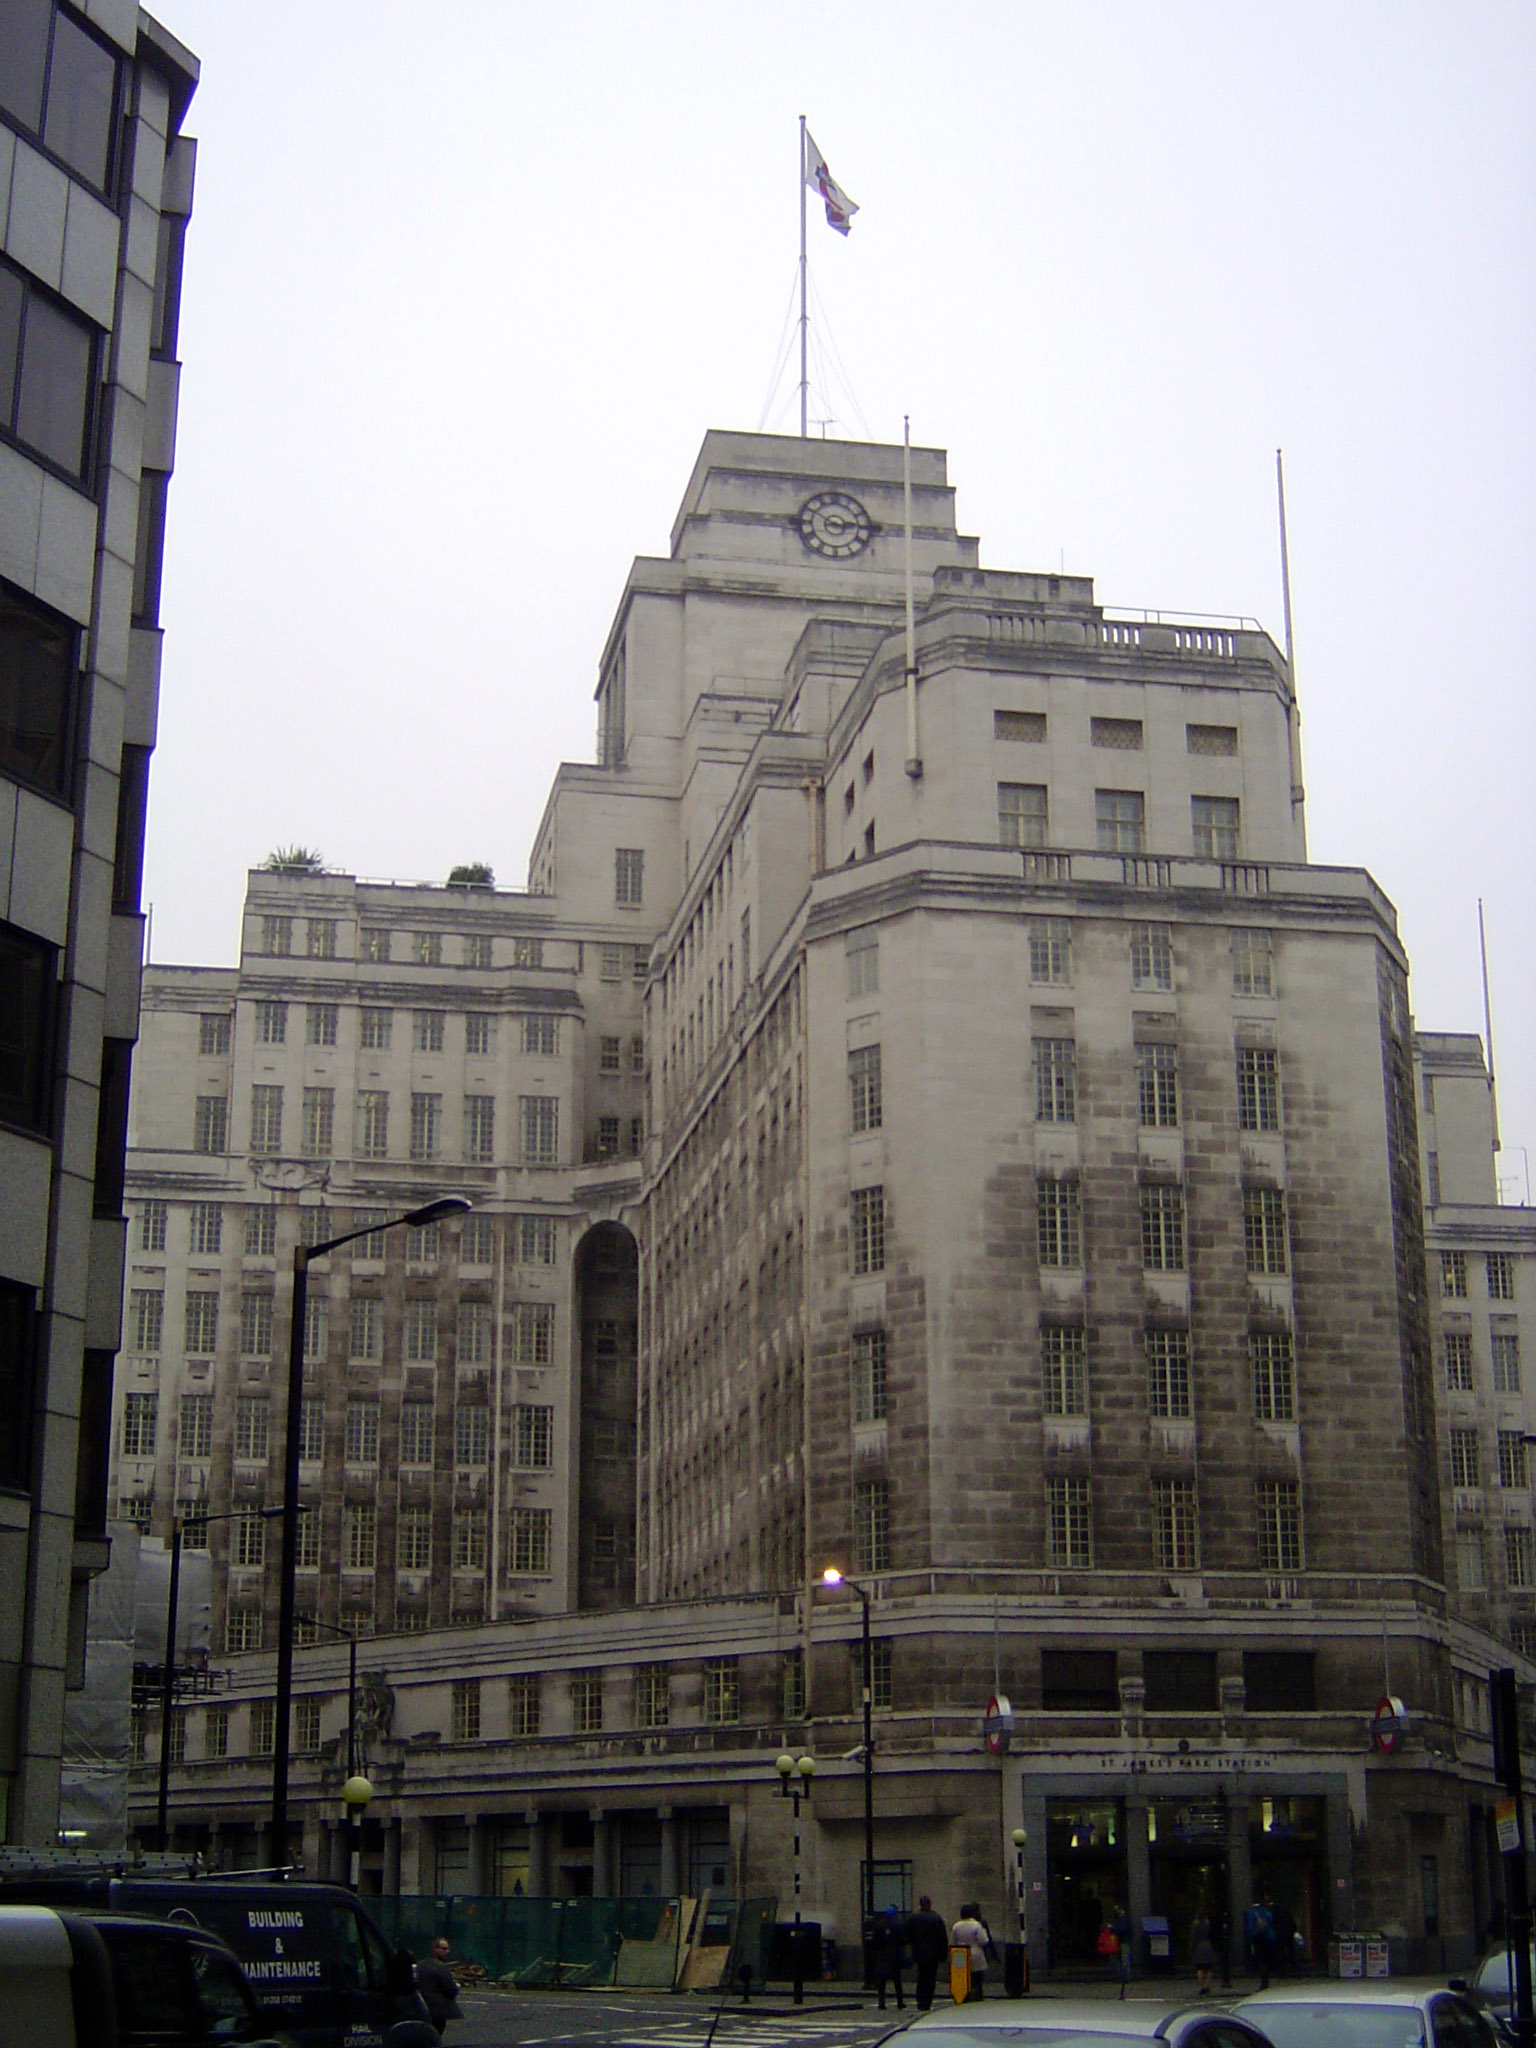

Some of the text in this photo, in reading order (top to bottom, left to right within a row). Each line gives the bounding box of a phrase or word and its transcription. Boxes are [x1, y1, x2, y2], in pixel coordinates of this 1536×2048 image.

[1179, 1759, 1209, 1768] PARK
[1218, 1759, 1271, 1768] STATION
[248, 1911, 304, 1928] BUILDING
[275, 1937, 285, 1954] &
[344, 2034, 383, 2048] DIVISION
